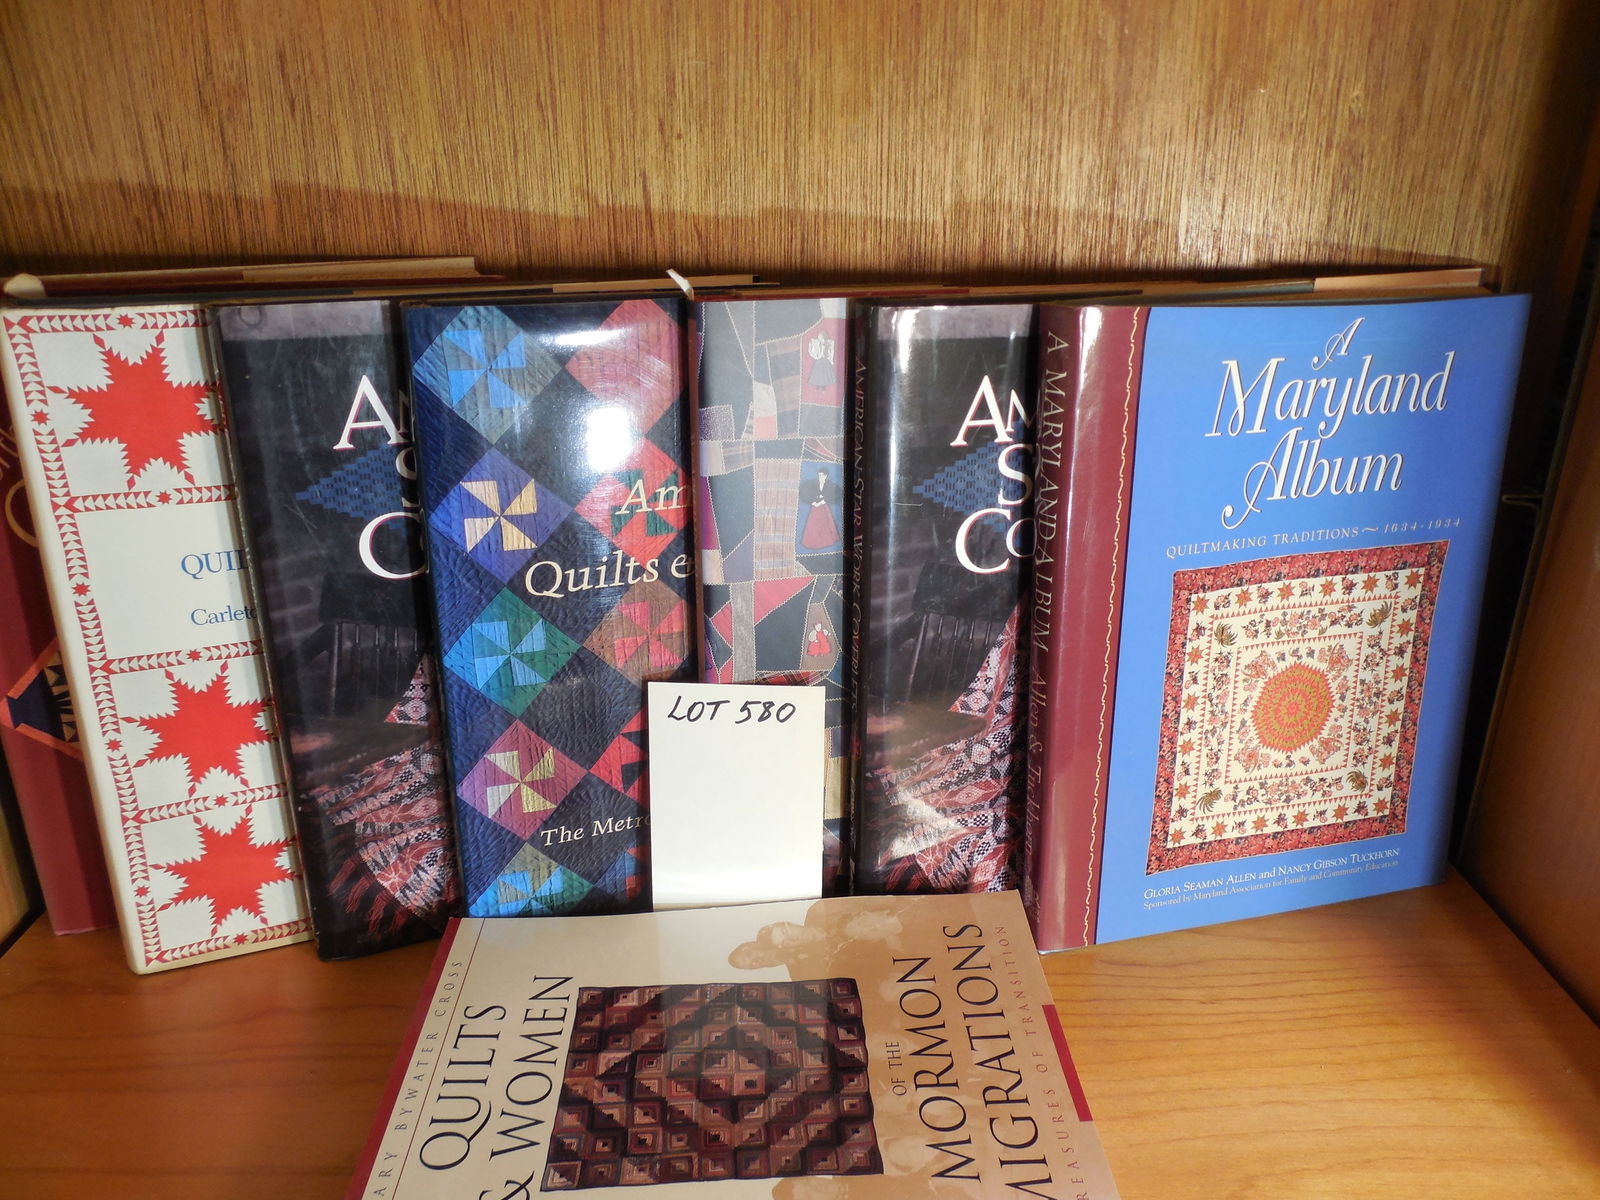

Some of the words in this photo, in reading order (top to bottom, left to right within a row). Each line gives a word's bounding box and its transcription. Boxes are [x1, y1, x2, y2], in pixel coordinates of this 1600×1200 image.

[1047, 330, 1069, 354] A
[1312, 317, 1365, 371] A
[1205, 350, 1456, 439] Maryland
[1038, 369, 1066, 541] MARYLAND
[1221, 426, 1404, 530] Album
[1166, 536, 1267, 559] QUILTMAKING
[1273, 526, 1359, 545] TRADITIONS
[1384, 517, 1461, 534] 1634-1934
[525, 550, 659, 598] Quilts
[1033, 546, 1055, 653] ALBUM
[668, 695, 729, 722] LOT
[735, 699, 796, 724] 580
[541, 826, 585, 847] The
[1144, 884, 1181, 899] GLORIA
[1183, 877, 1224, 892] SEAMAN
[1226, 871, 1257, 885] ALLEN
[1258, 866, 1277, 880] and
[1278, 862, 1312, 876] NANCY
[1313, 856, 1349, 871] GIBSON
[1350, 847, 1400, 864] TUCKHORN
[1144, 894, 1181, 911] Sponsored
[1182, 893, 1192, 904] by
[1193, 887, 1229, 902] Maryland
[1230, 879, 1271, 895] Association
[1272, 878, 1283, 889] for
[1284, 872, 1307, 886] Family
[1309, 871, 1323, 881] and
[995, 926, 1037, 1036] TRANSITION
[395, 1031, 438, 1131] BYWATER
[434, 961, 463, 1018] CROSS
[489, 975, 574, 1162] WOMEN
[886, 1041, 902, 1069] THE
[892, 956, 982, 1183] MORMON
[1032, 1051, 1048, 1073] OF
[419, 1005, 506, 1170] QUILTS
[892, 1078, 907, 1096] OF
